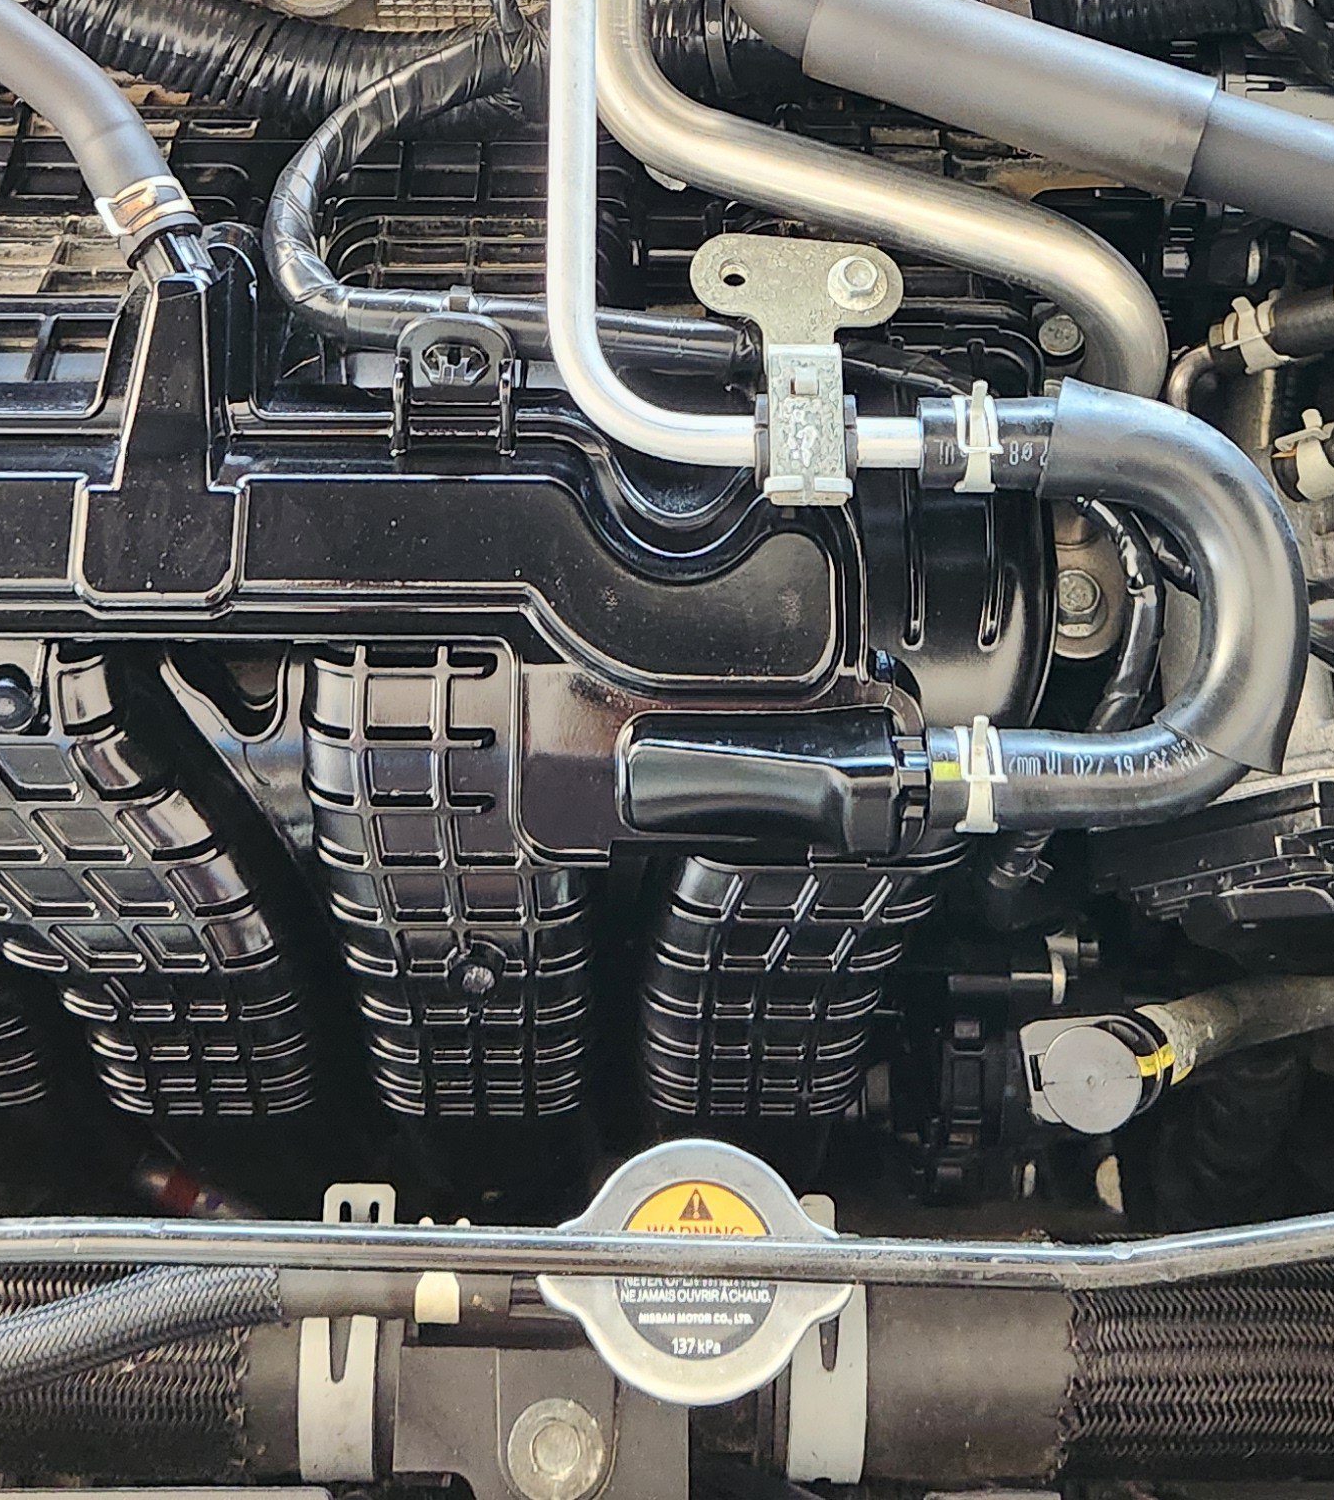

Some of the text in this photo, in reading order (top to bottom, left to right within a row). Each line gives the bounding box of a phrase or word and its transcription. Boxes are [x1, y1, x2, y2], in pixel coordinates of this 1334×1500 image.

[620, 1288, 636, 1303] NE
[637, 1288, 676, 1303] JAMAIS
[677, 1288, 720, 1303] OUVRIR
[638, 1312, 675, 1324] NISSAN
[676, 1312, 712, 1324] MOTOR
[671, 1336, 721, 1355] 137 kPa
